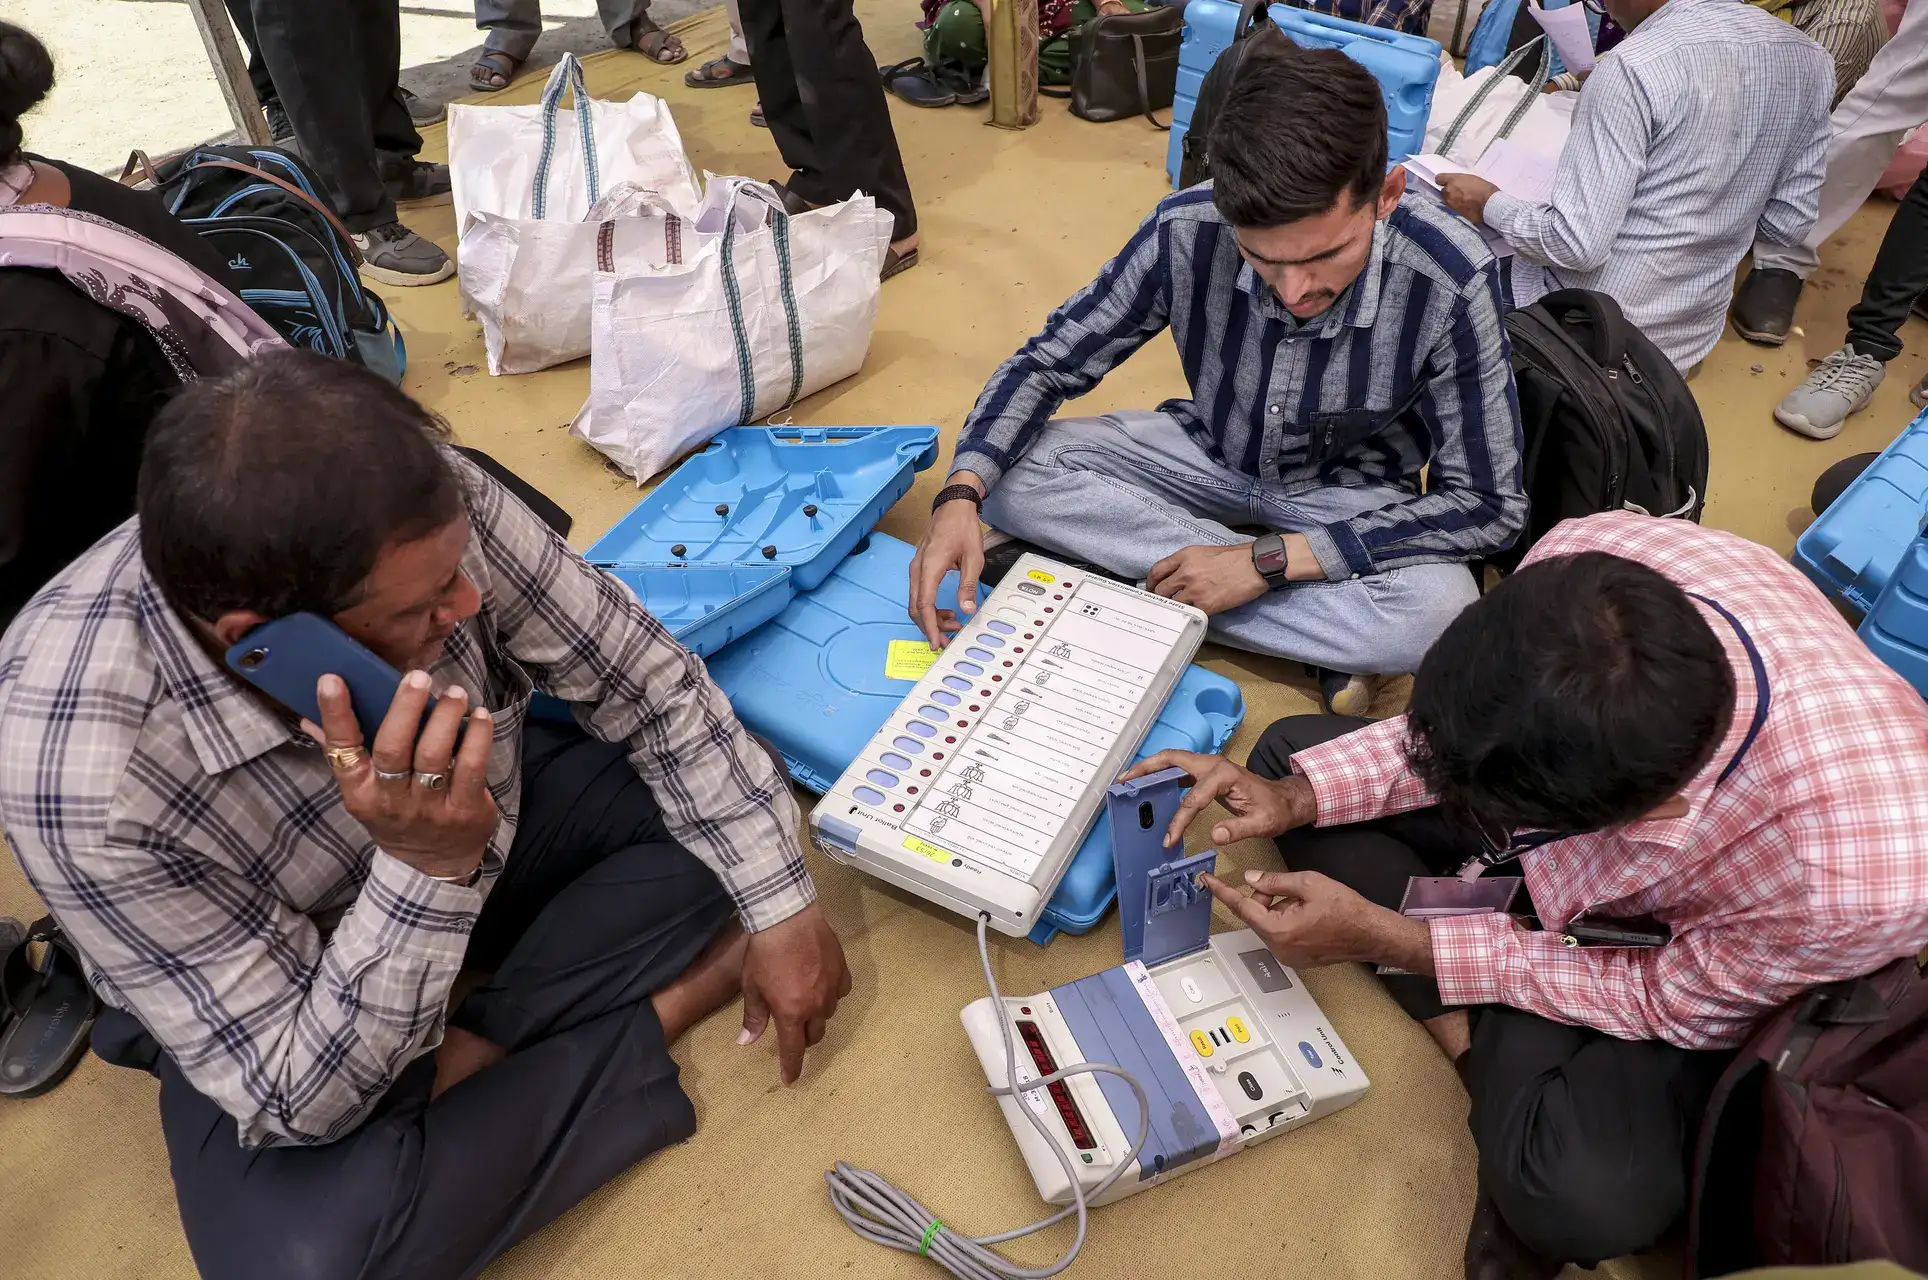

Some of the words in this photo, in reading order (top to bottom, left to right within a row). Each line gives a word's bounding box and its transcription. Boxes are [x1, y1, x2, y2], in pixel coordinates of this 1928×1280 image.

[1084, 573, 1107, 583] Gujarat
[1019, 584, 1040, 595] NOTA
[1142, 592, 1167, 603] Election
[1168, 600, 1185, 609] State
[856, 809, 873, 820] Unit
[874, 817, 898, 831] Ballot
[963, 862, 981, 874] Ready
[1315, 1026, 1328, 1040] Unit
[1197, 1036, 1207, 1050] Result
[1324, 1040, 1344, 1065] Control
[1246, 1078, 1256, 1092] Close
